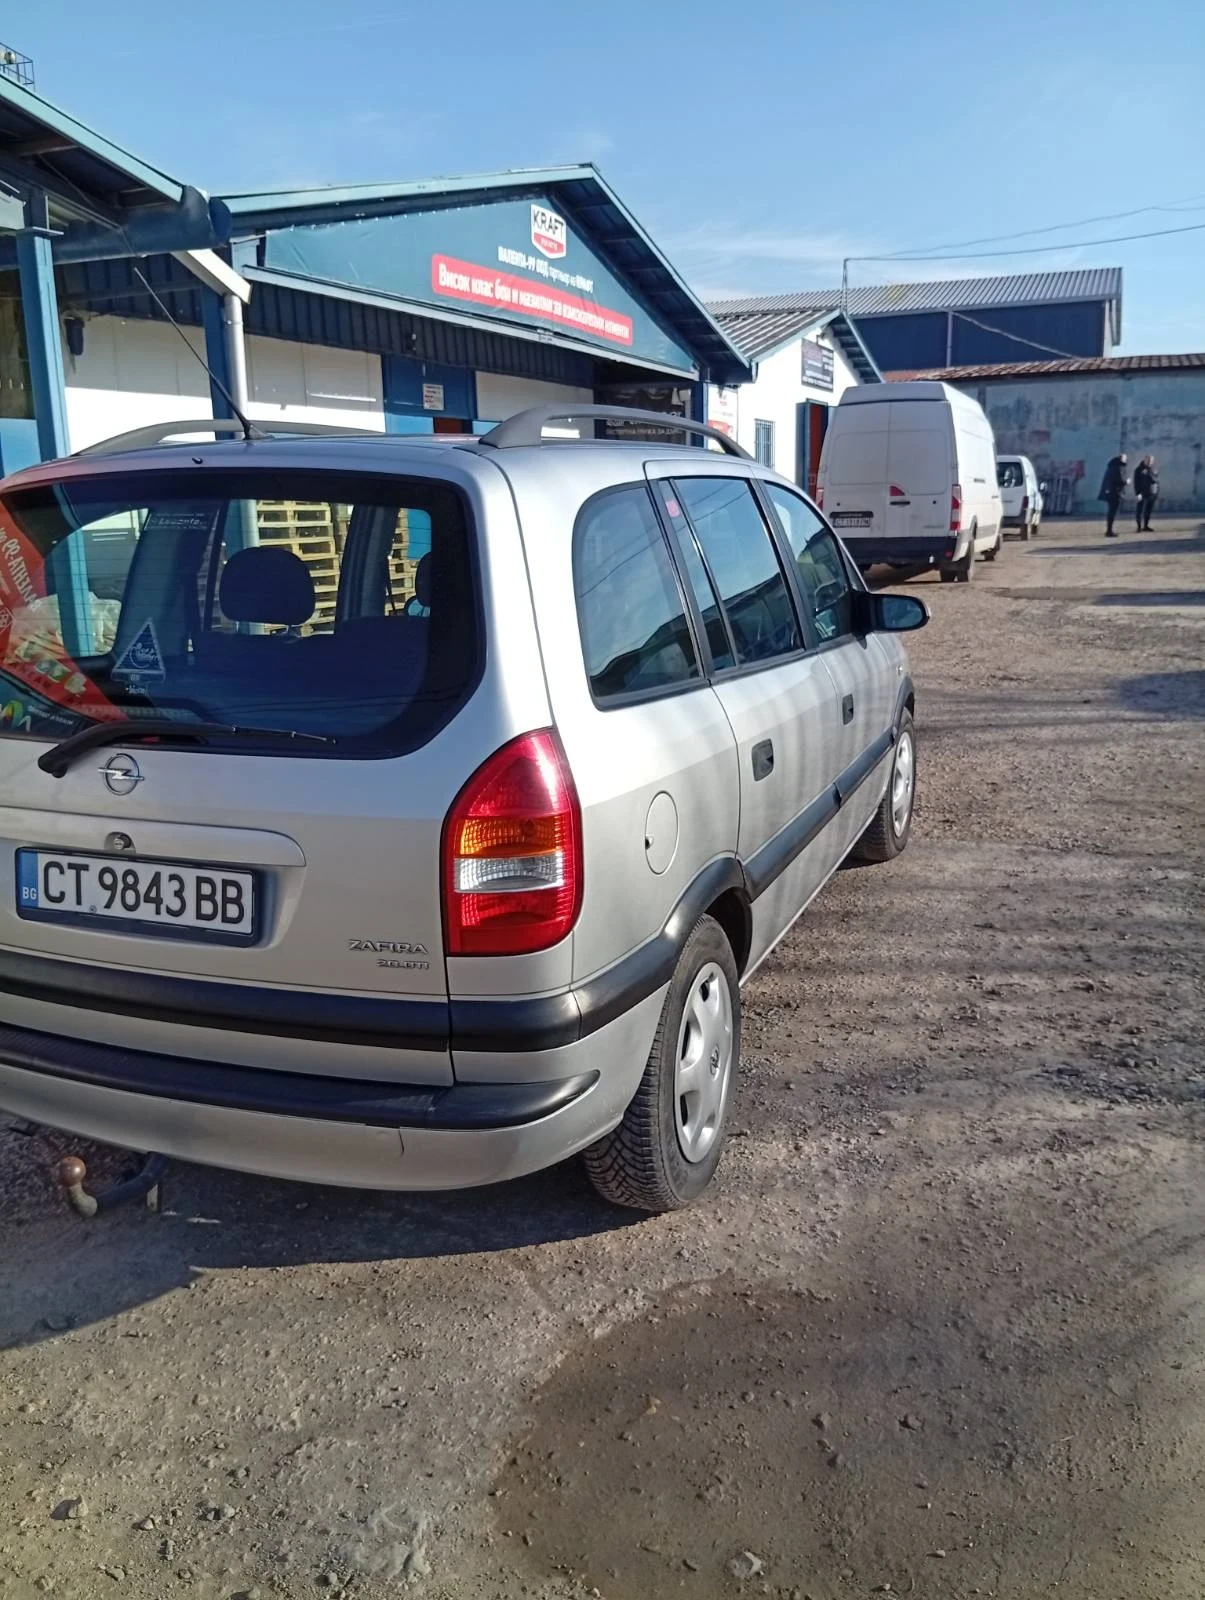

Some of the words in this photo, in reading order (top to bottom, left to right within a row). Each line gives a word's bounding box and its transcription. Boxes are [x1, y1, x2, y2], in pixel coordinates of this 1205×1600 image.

[533, 209, 564, 240] KRAFT
[439, 263, 470, 293] Висок
[22, 886, 37, 900] BG
[97, 866, 187, 918] 9843
[348, 938, 429, 955] ZAFIRA
